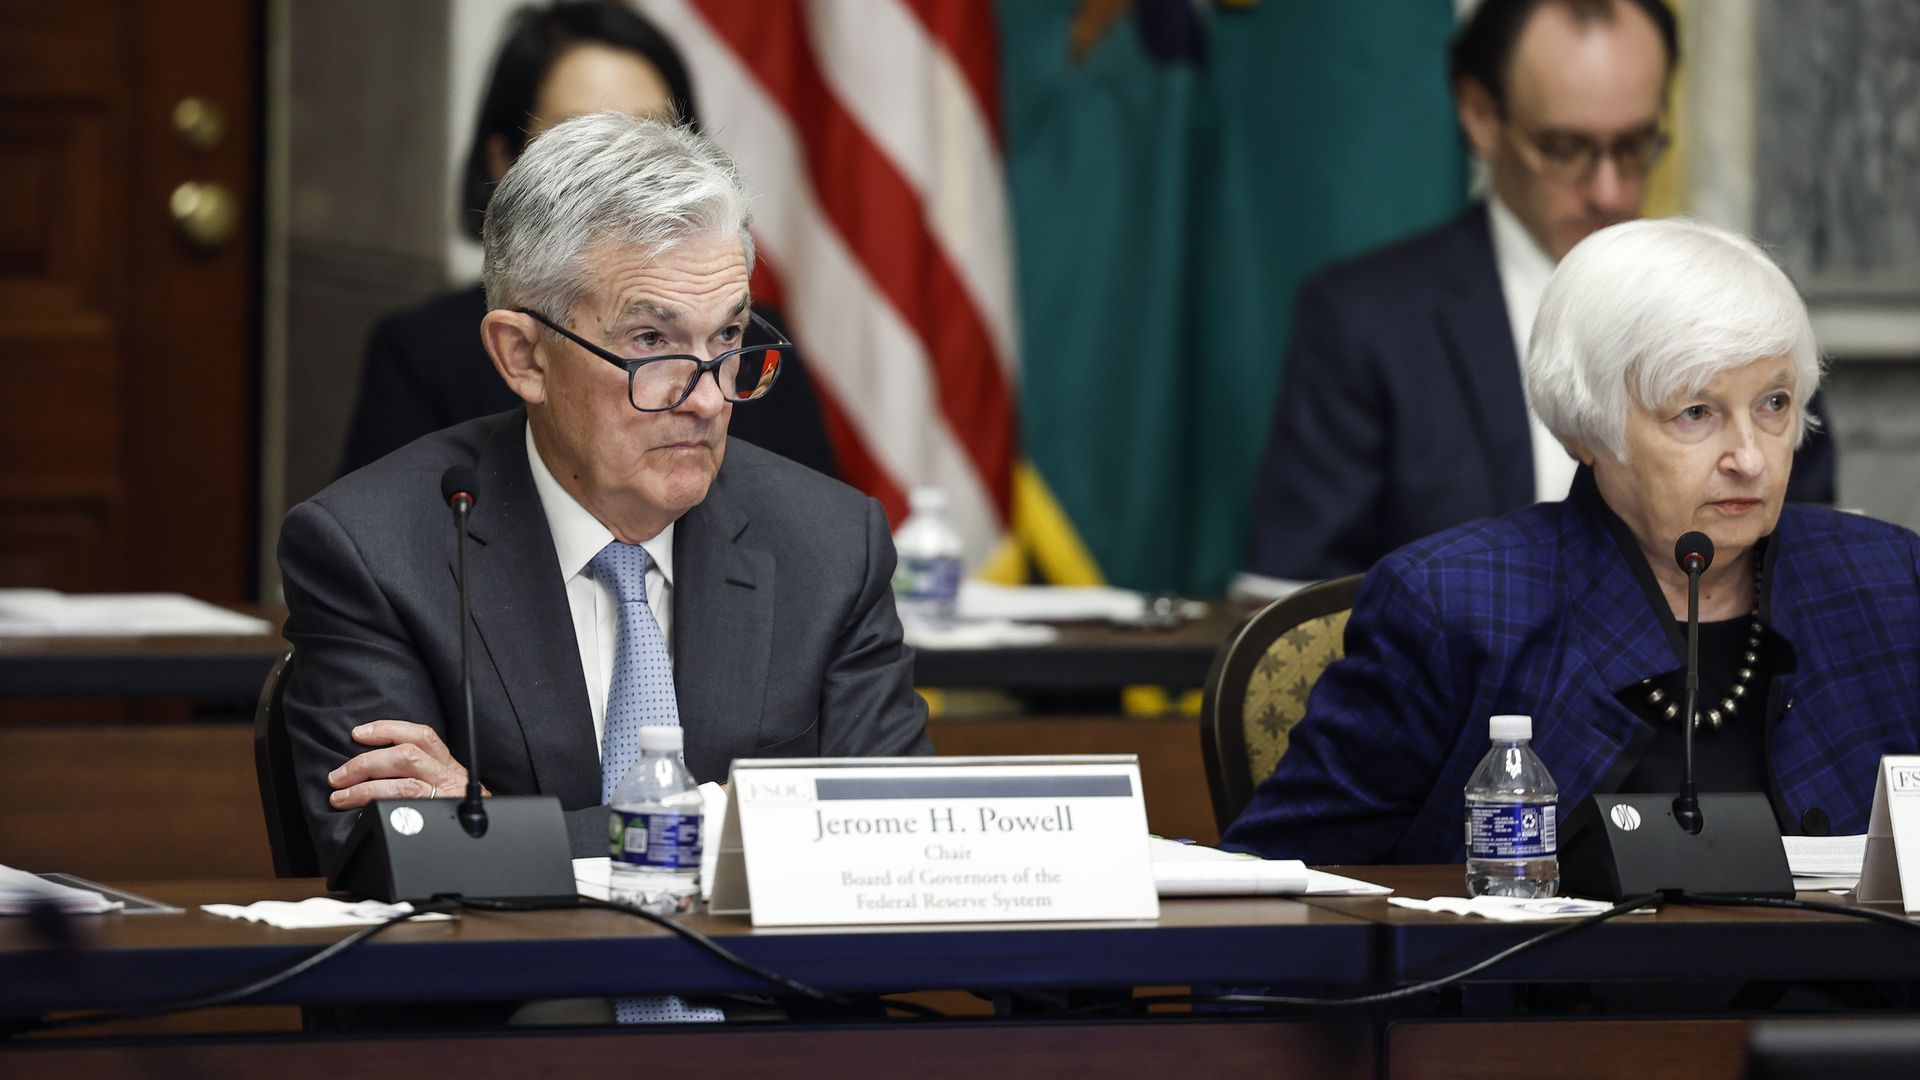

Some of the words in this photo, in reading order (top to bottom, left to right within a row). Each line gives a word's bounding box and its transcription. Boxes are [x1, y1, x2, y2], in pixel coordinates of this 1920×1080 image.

[813, 808, 918, 842] Jerome
[928, 807, 967, 833] H.
[977, 804, 1074, 833] Powell
[924, 844, 972, 861] Chair
[841, 869, 892, 887] Board
[897, 868, 916, 886] of
[919, 868, 1008, 886] Governors
[1012, 867, 1031, 885] of
[1035, 867, 1062, 885] the
[856, 892, 918, 910] Federal
[922, 891, 988, 909] Reserve
[992, 890, 1053, 912] System
